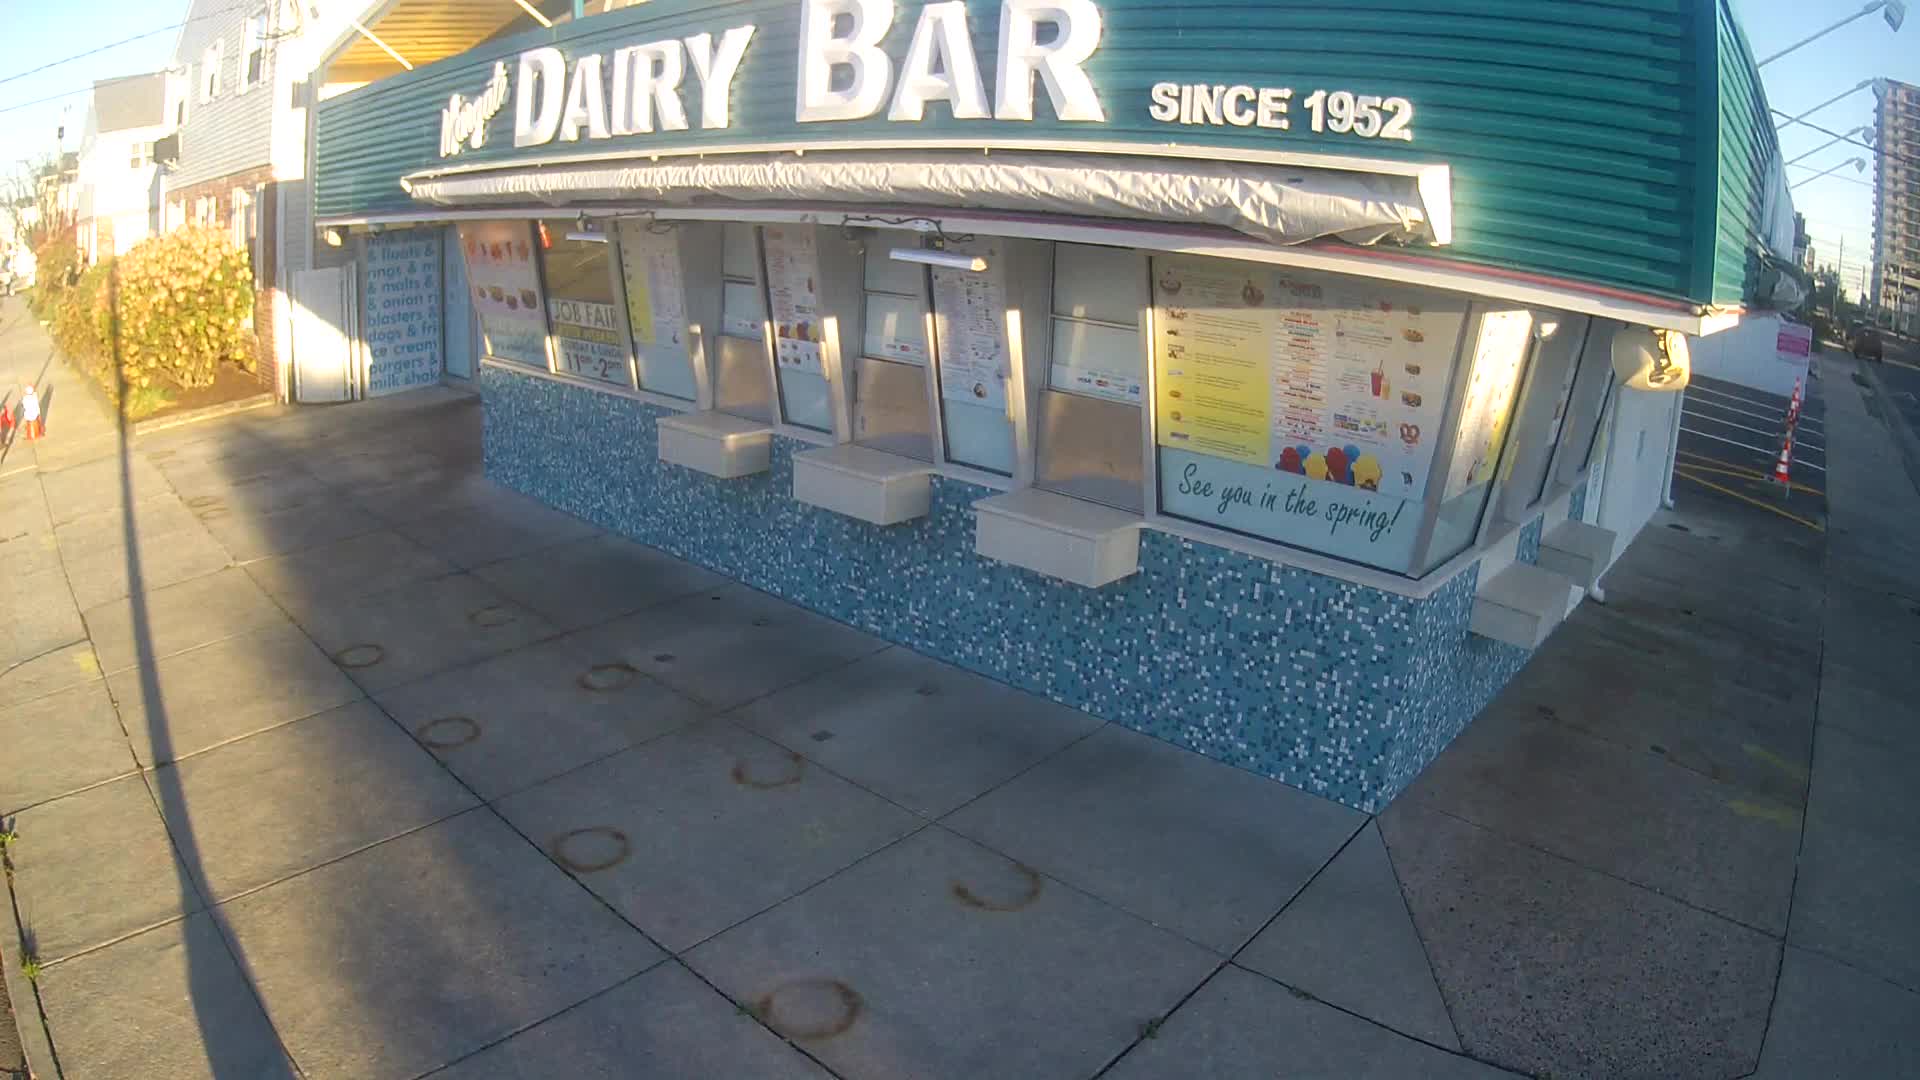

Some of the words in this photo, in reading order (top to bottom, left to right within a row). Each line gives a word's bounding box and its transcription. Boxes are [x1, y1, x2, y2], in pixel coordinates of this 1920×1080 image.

[514, 25, 757, 147] DAIRY
[796, 0, 1105, 122] BAR
[1149, 82, 1293, 130] SINCE
[1303, 89, 1413, 142] 1952
[383, 294, 424, 309] onion
[554, 300, 583, 323] JOB
[369, 329, 401, 346] dogs
[1179, 463, 1214, 496] See
[1217, 484, 1253, 514] you
[1259, 483, 1277, 513] in
[1284, 483, 1318, 517] the
[1325, 498, 1408, 542] spring!
